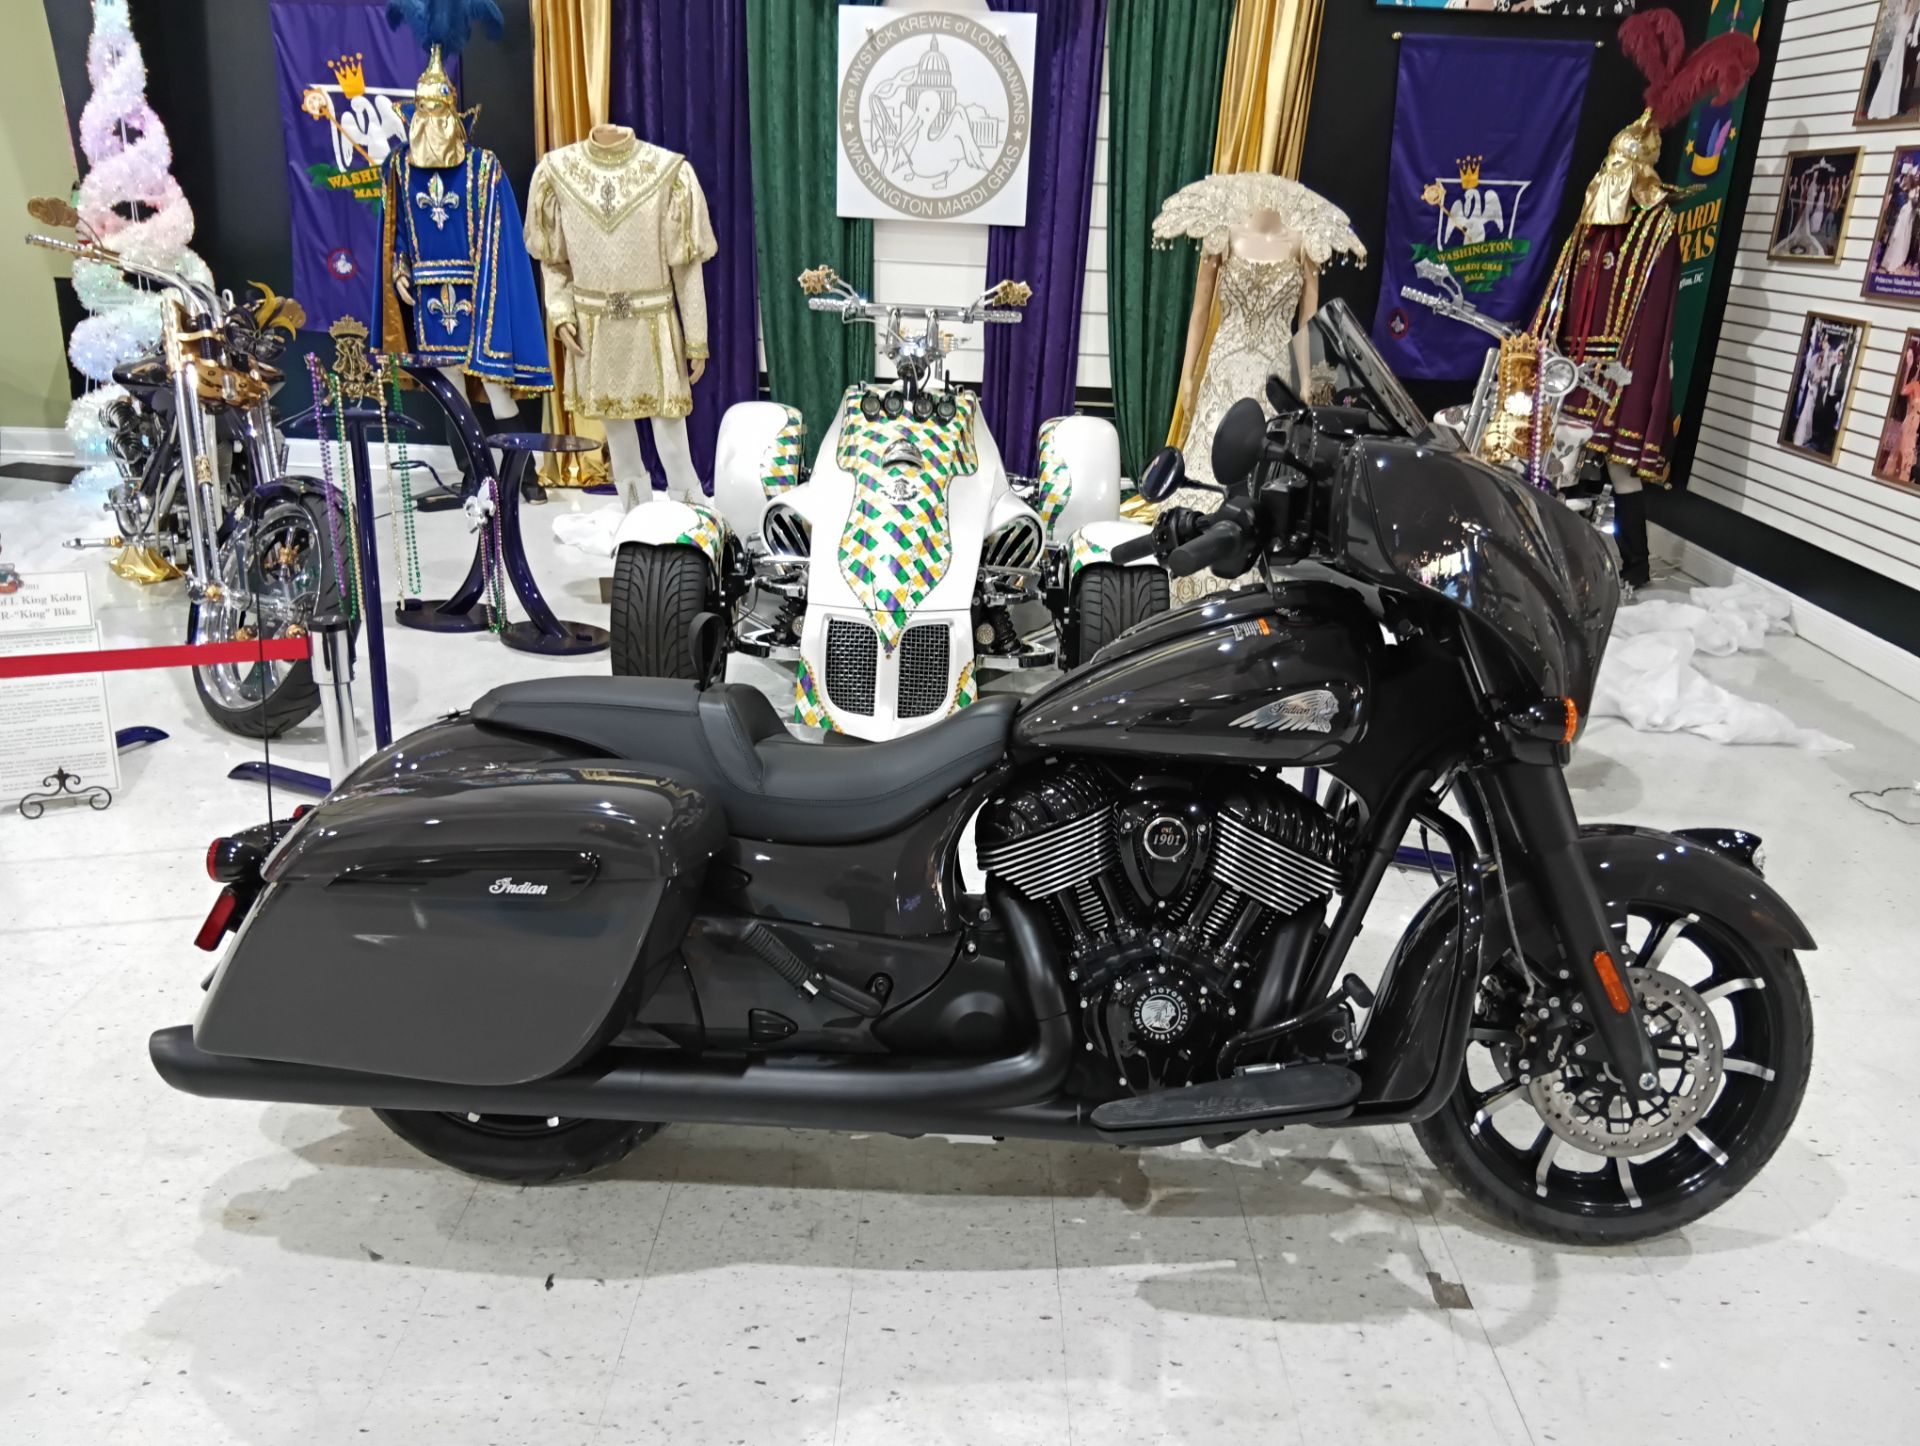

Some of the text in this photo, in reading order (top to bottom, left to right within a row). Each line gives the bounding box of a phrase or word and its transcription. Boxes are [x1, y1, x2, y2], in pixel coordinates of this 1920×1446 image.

[843, 15, 1025, 125] The MYSTICK KREWE of LOUISIANIANS
[328, 167, 381, 189] WASHI
[847, 136, 1020, 216] WASHINGTON MARDI GRAS
[353, 188, 381, 198] MAR
[1437, 241, 1514, 262] WASHINGTON
[1680, 225, 1717, 264] RAS
[1454, 262, 1503, 273] MARDI GRAS
[22, 595, 47, 605] King
[51, 593, 81, 603] Kobra
[54, 607, 77, 617] Bike
[1269, 703, 1311, 716] Indian
[1153, 833, 1181, 846] 1901
[488, 877, 548, 895] Indian
[1134, 987, 1188, 1031] INDIAN MOTORCYCLE
